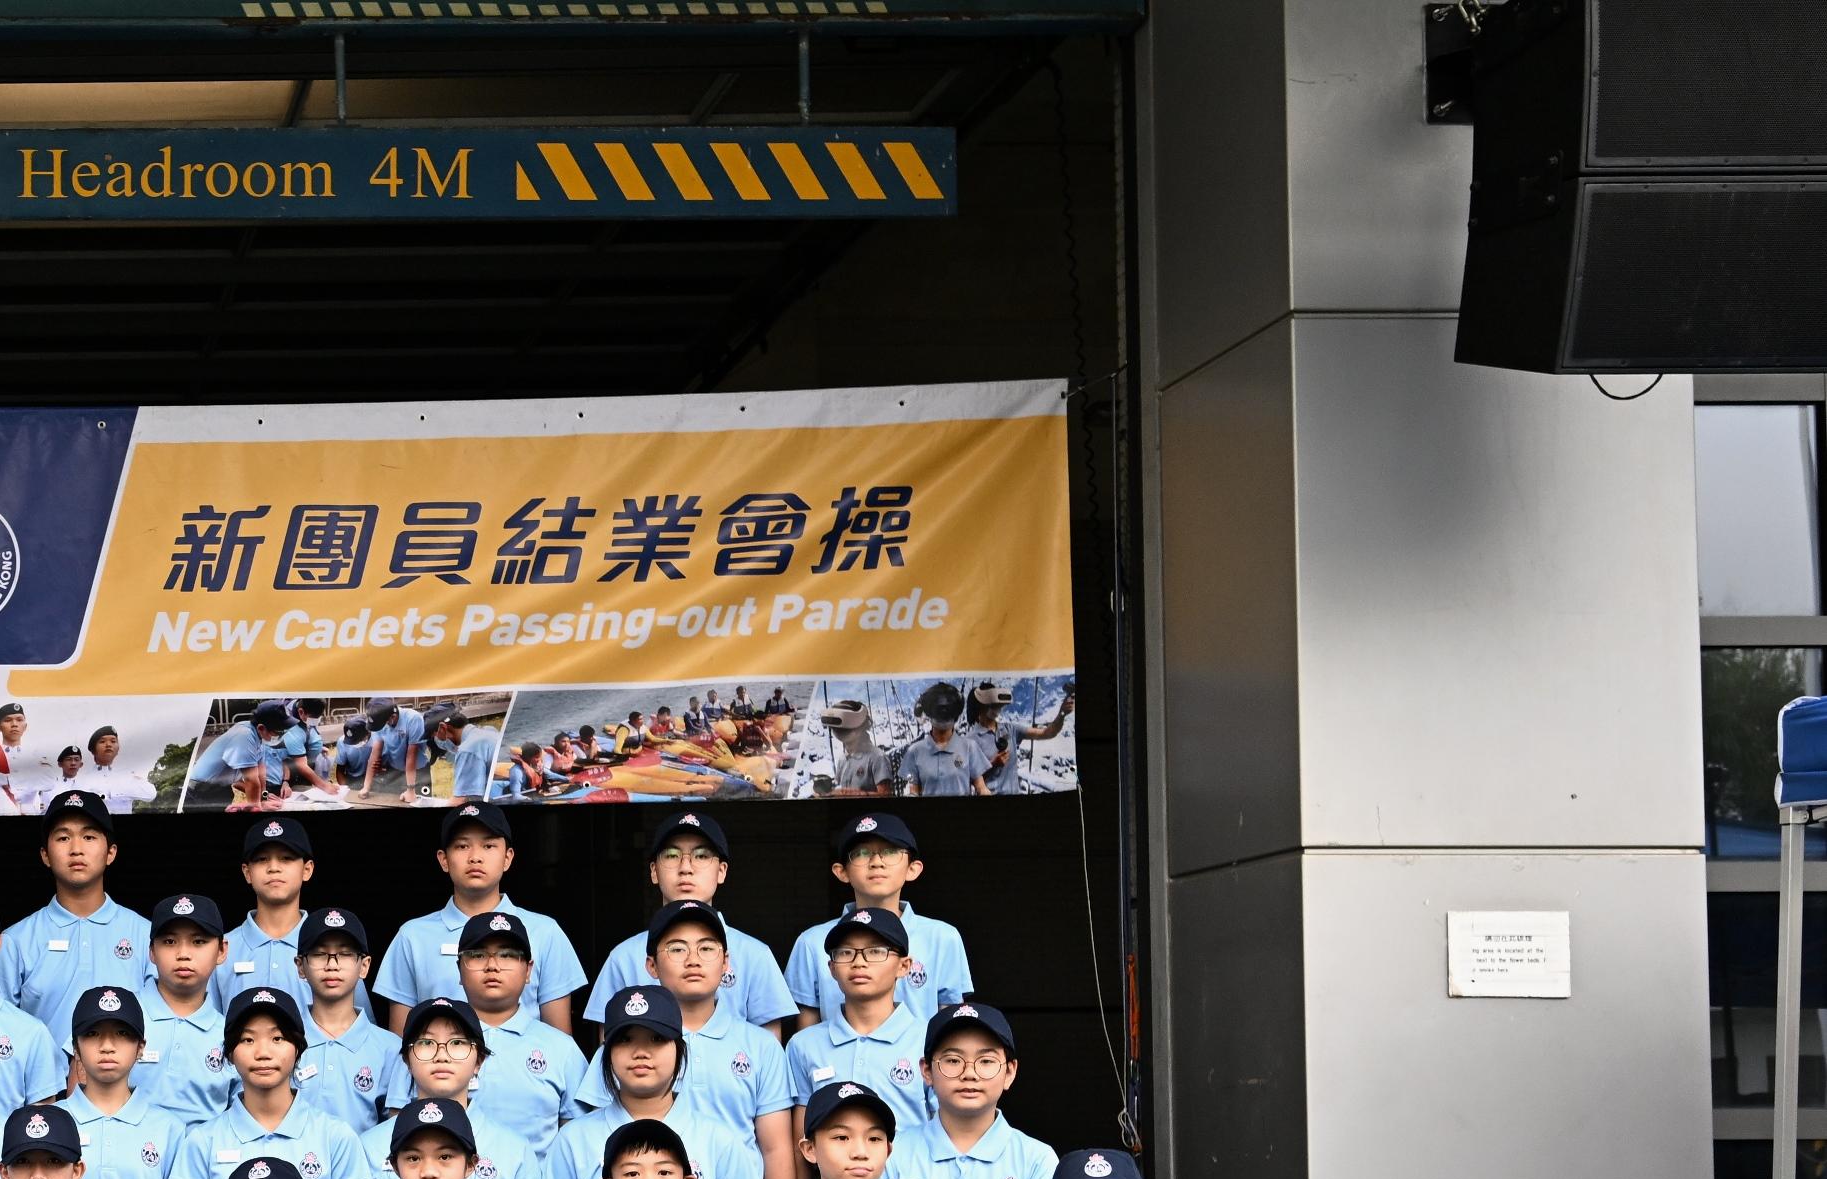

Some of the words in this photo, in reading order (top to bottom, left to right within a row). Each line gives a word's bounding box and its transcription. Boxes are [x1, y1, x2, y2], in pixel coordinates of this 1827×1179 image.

[21, 146, 334, 199] Headroom
[369, 147, 471, 199] 4M
[162, 485, 914, 593] 新團員結業會操
[146, 611, 266, 653] New
[273, 607, 448, 651] Cadets
[457, 595, 757, 648] Passing-out
[767, 587, 950, 634] Parade
